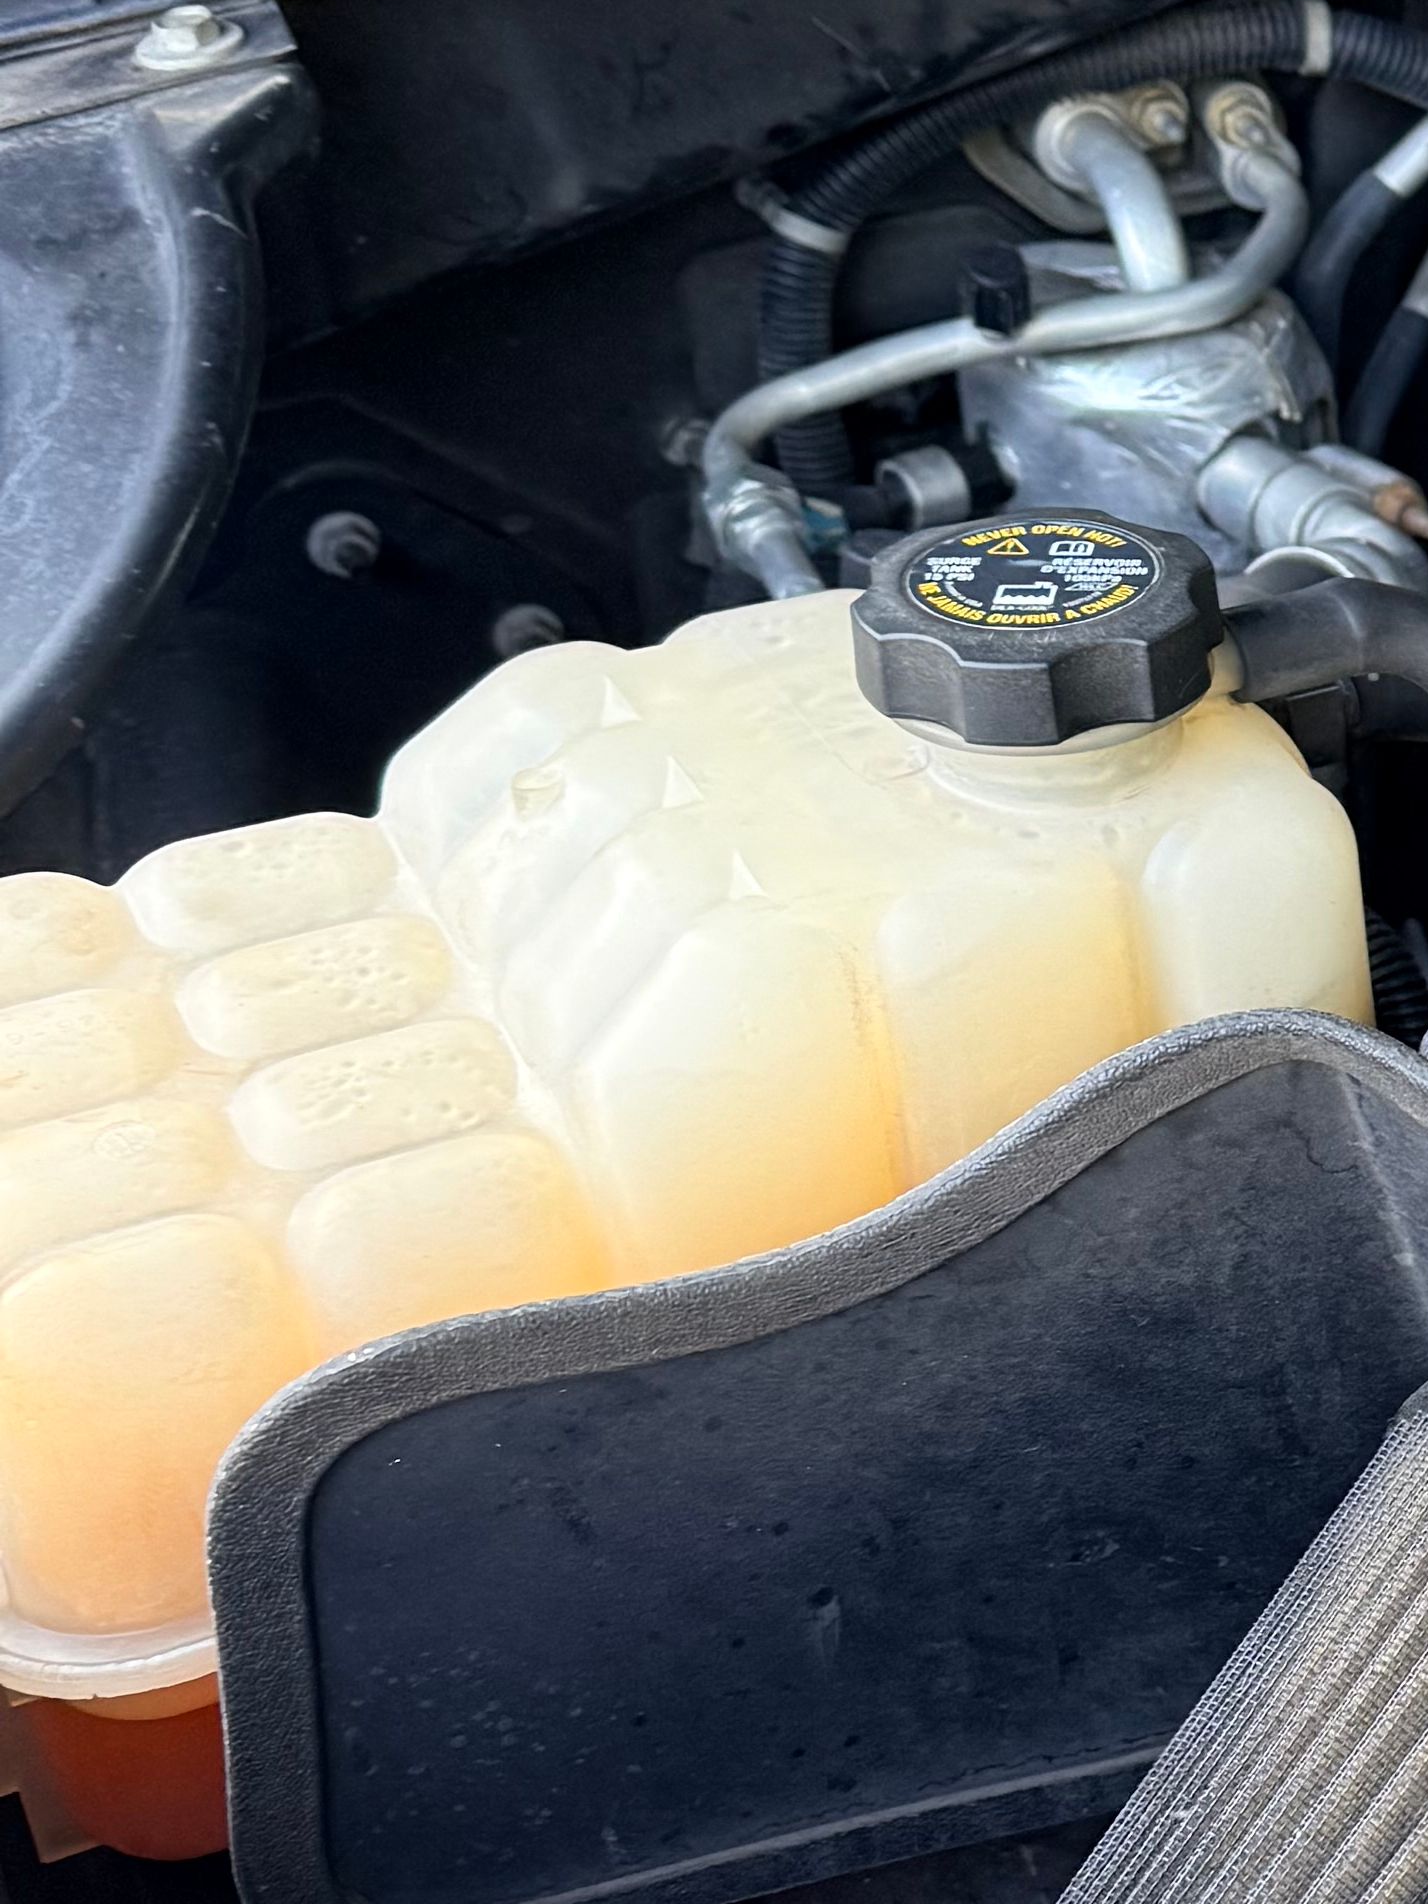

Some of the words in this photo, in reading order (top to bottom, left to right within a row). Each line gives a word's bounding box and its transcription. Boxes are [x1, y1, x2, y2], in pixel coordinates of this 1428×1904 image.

[962, 526, 1028, 547] NEVER
[1030, 524, 1086, 538] OPEN
[1083, 529, 1129, 548] HOT!
[926, 556, 983, 566] SURGE
[930, 564, 974, 574] TANK
[926, 595, 988, 622] JAMAIS
[986, 612, 1061, 626] OUVRIR
